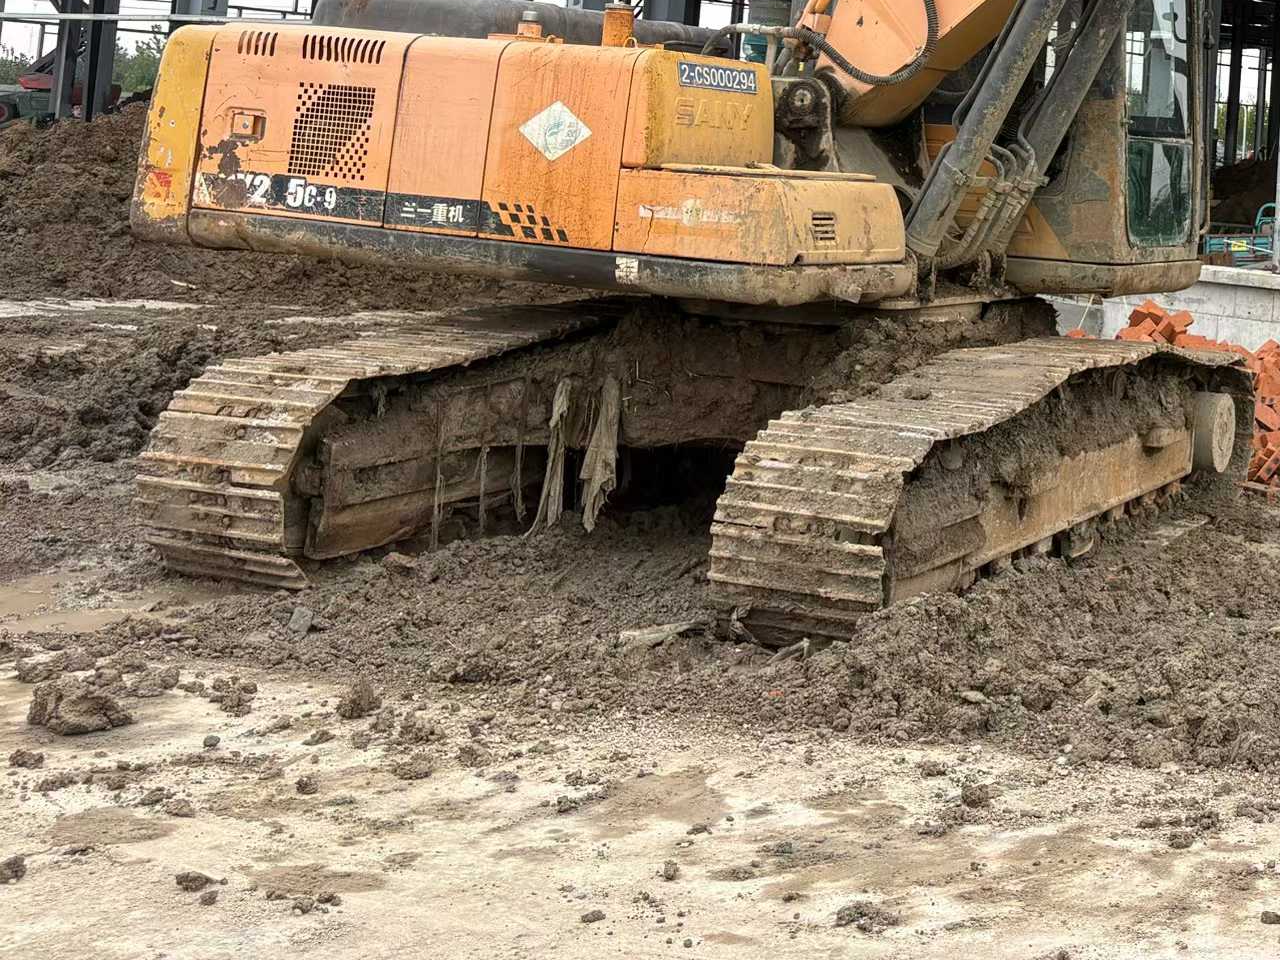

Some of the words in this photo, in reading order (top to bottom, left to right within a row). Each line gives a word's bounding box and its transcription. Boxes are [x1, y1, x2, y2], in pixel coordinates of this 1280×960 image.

[680, 63, 756, 91] 2-CS000294
[675, 97, 754, 130] SANY
[400, 201, 466, 224] 三一重机
